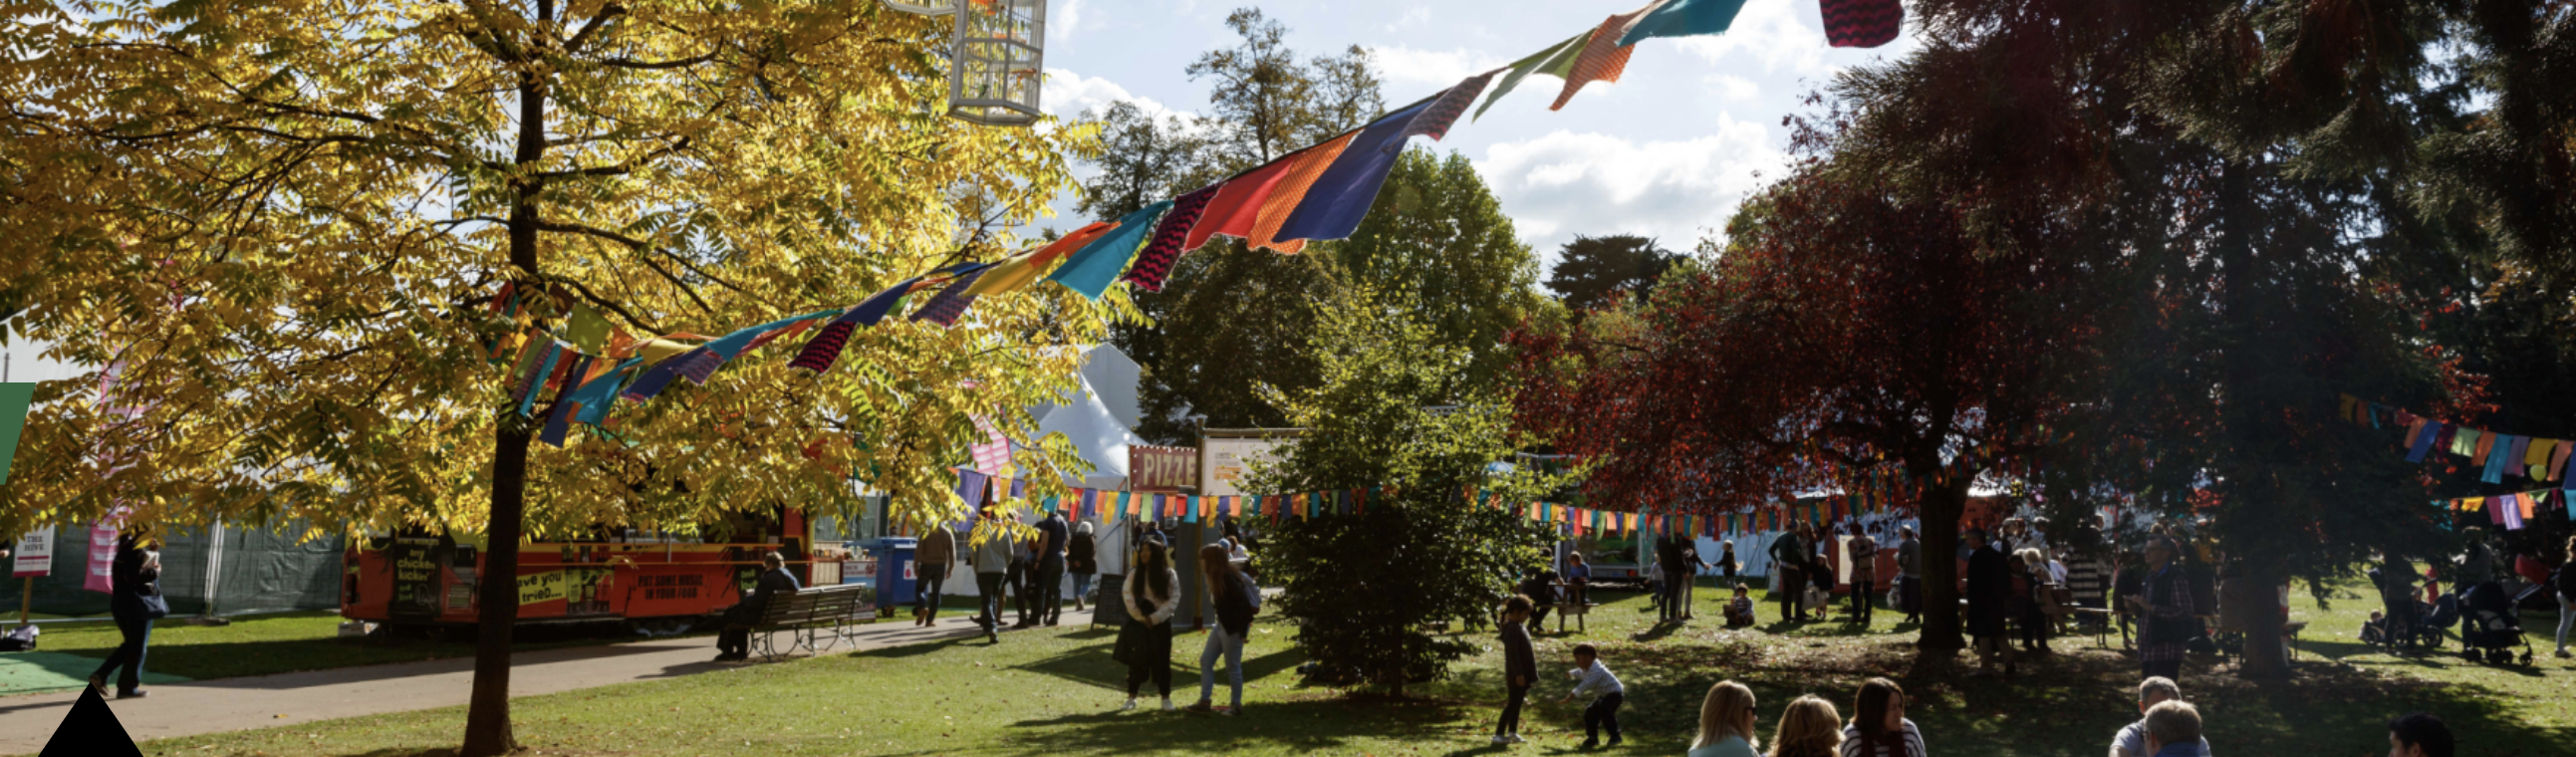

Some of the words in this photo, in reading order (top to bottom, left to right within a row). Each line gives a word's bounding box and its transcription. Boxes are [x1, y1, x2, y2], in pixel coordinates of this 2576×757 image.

[1143, 453, 1195, 486] PIZZE
[397, 557, 435, 571] chicken
[517, 576, 537, 589] ave
[541, 573, 561, 587] you
[639, 575, 653, 587] PUT
[655, 575, 676, 587] SOME
[644, 588, 653, 600] IN
[655, 588, 676, 599] YOUR
